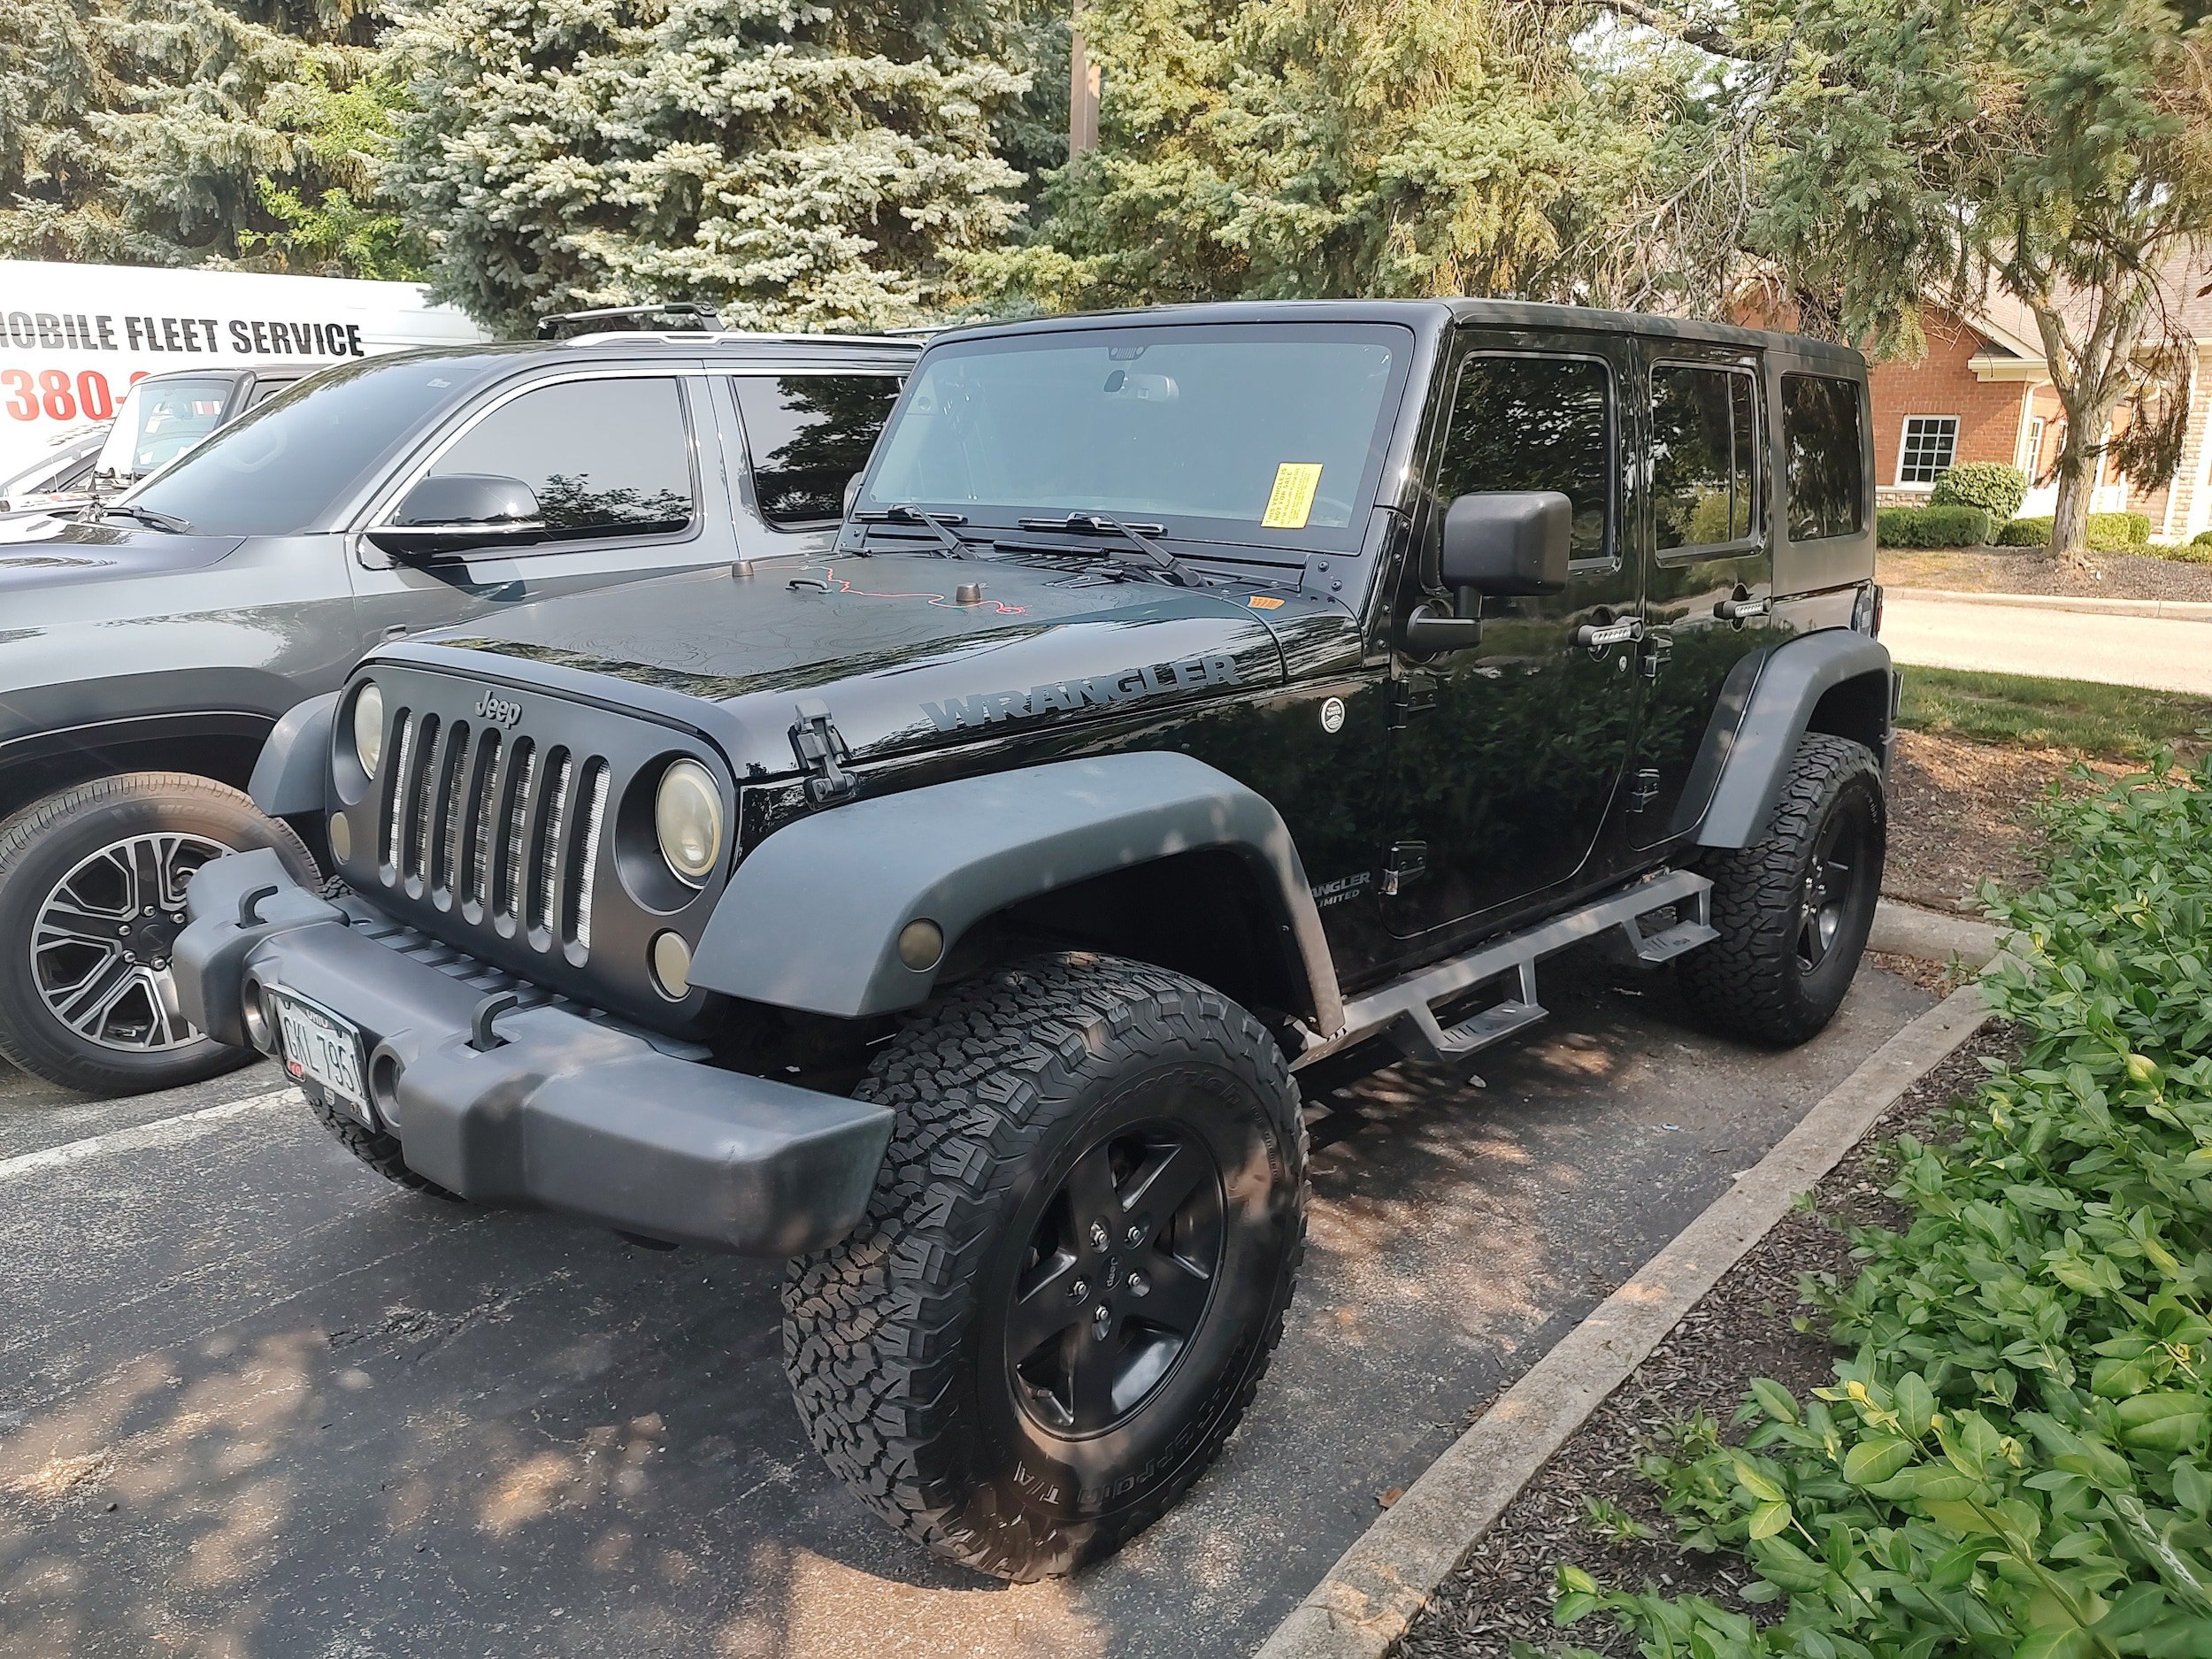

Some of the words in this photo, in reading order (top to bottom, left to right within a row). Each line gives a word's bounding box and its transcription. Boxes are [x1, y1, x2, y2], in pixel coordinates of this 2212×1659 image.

[126, 316, 220, 353] FLEET
[228, 319, 365, 358] SERVICE
[1, 369, 151, 421] 380-
[474, 689, 522, 730] Jeep
[918, 655, 1243, 733] WRANGLER
[305, 1008, 328, 1028] OHIO
[284, 1016, 319, 1074] GKL
[316, 1033, 366, 1099] 7951
[1103, 1256, 1118, 1287] Jeep
